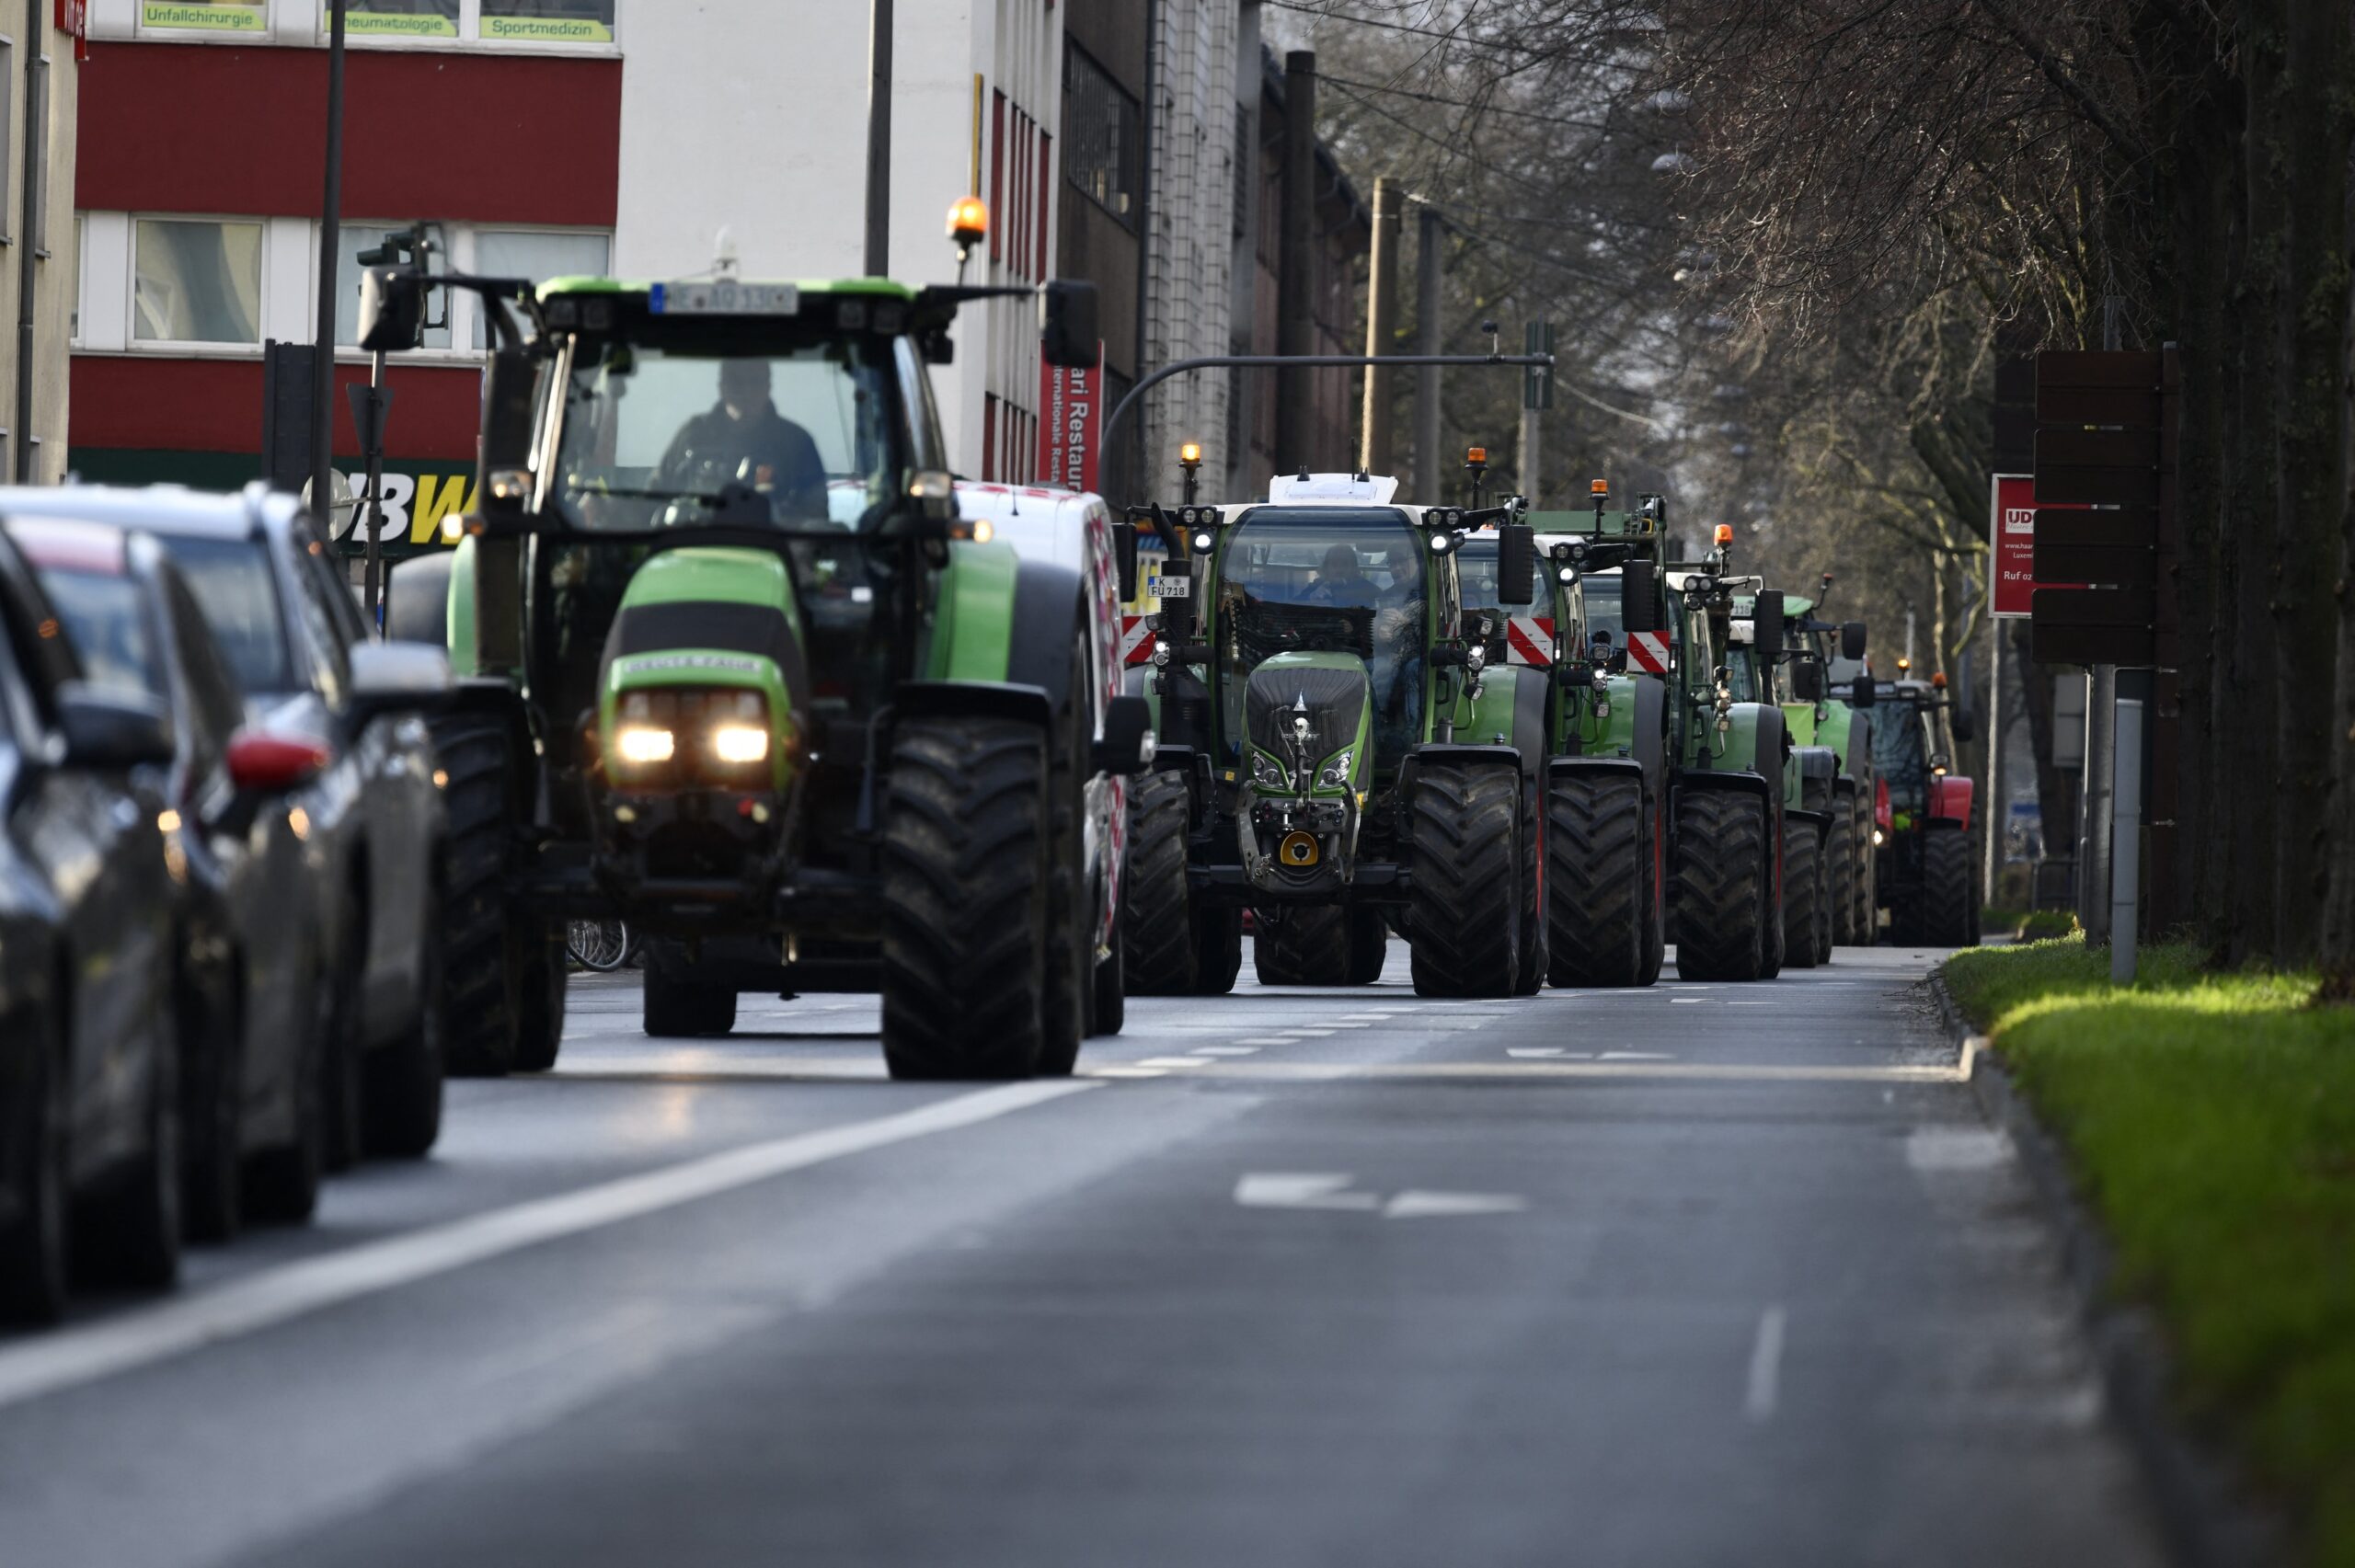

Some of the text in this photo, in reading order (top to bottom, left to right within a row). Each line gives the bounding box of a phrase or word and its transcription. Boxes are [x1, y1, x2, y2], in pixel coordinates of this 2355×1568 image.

[147, 7, 253, 27] Unfallchirurgie
[492, 19, 592, 36] Sportmedizin
[1051, 366, 1064, 482] ternationale Resta
[1067, 368, 1088, 493] ari Restaur
[2008, 511, 2032, 524] UD
[2004, 571, 2021, 580] Ruf
[1166, 587, 1185, 595] 718
